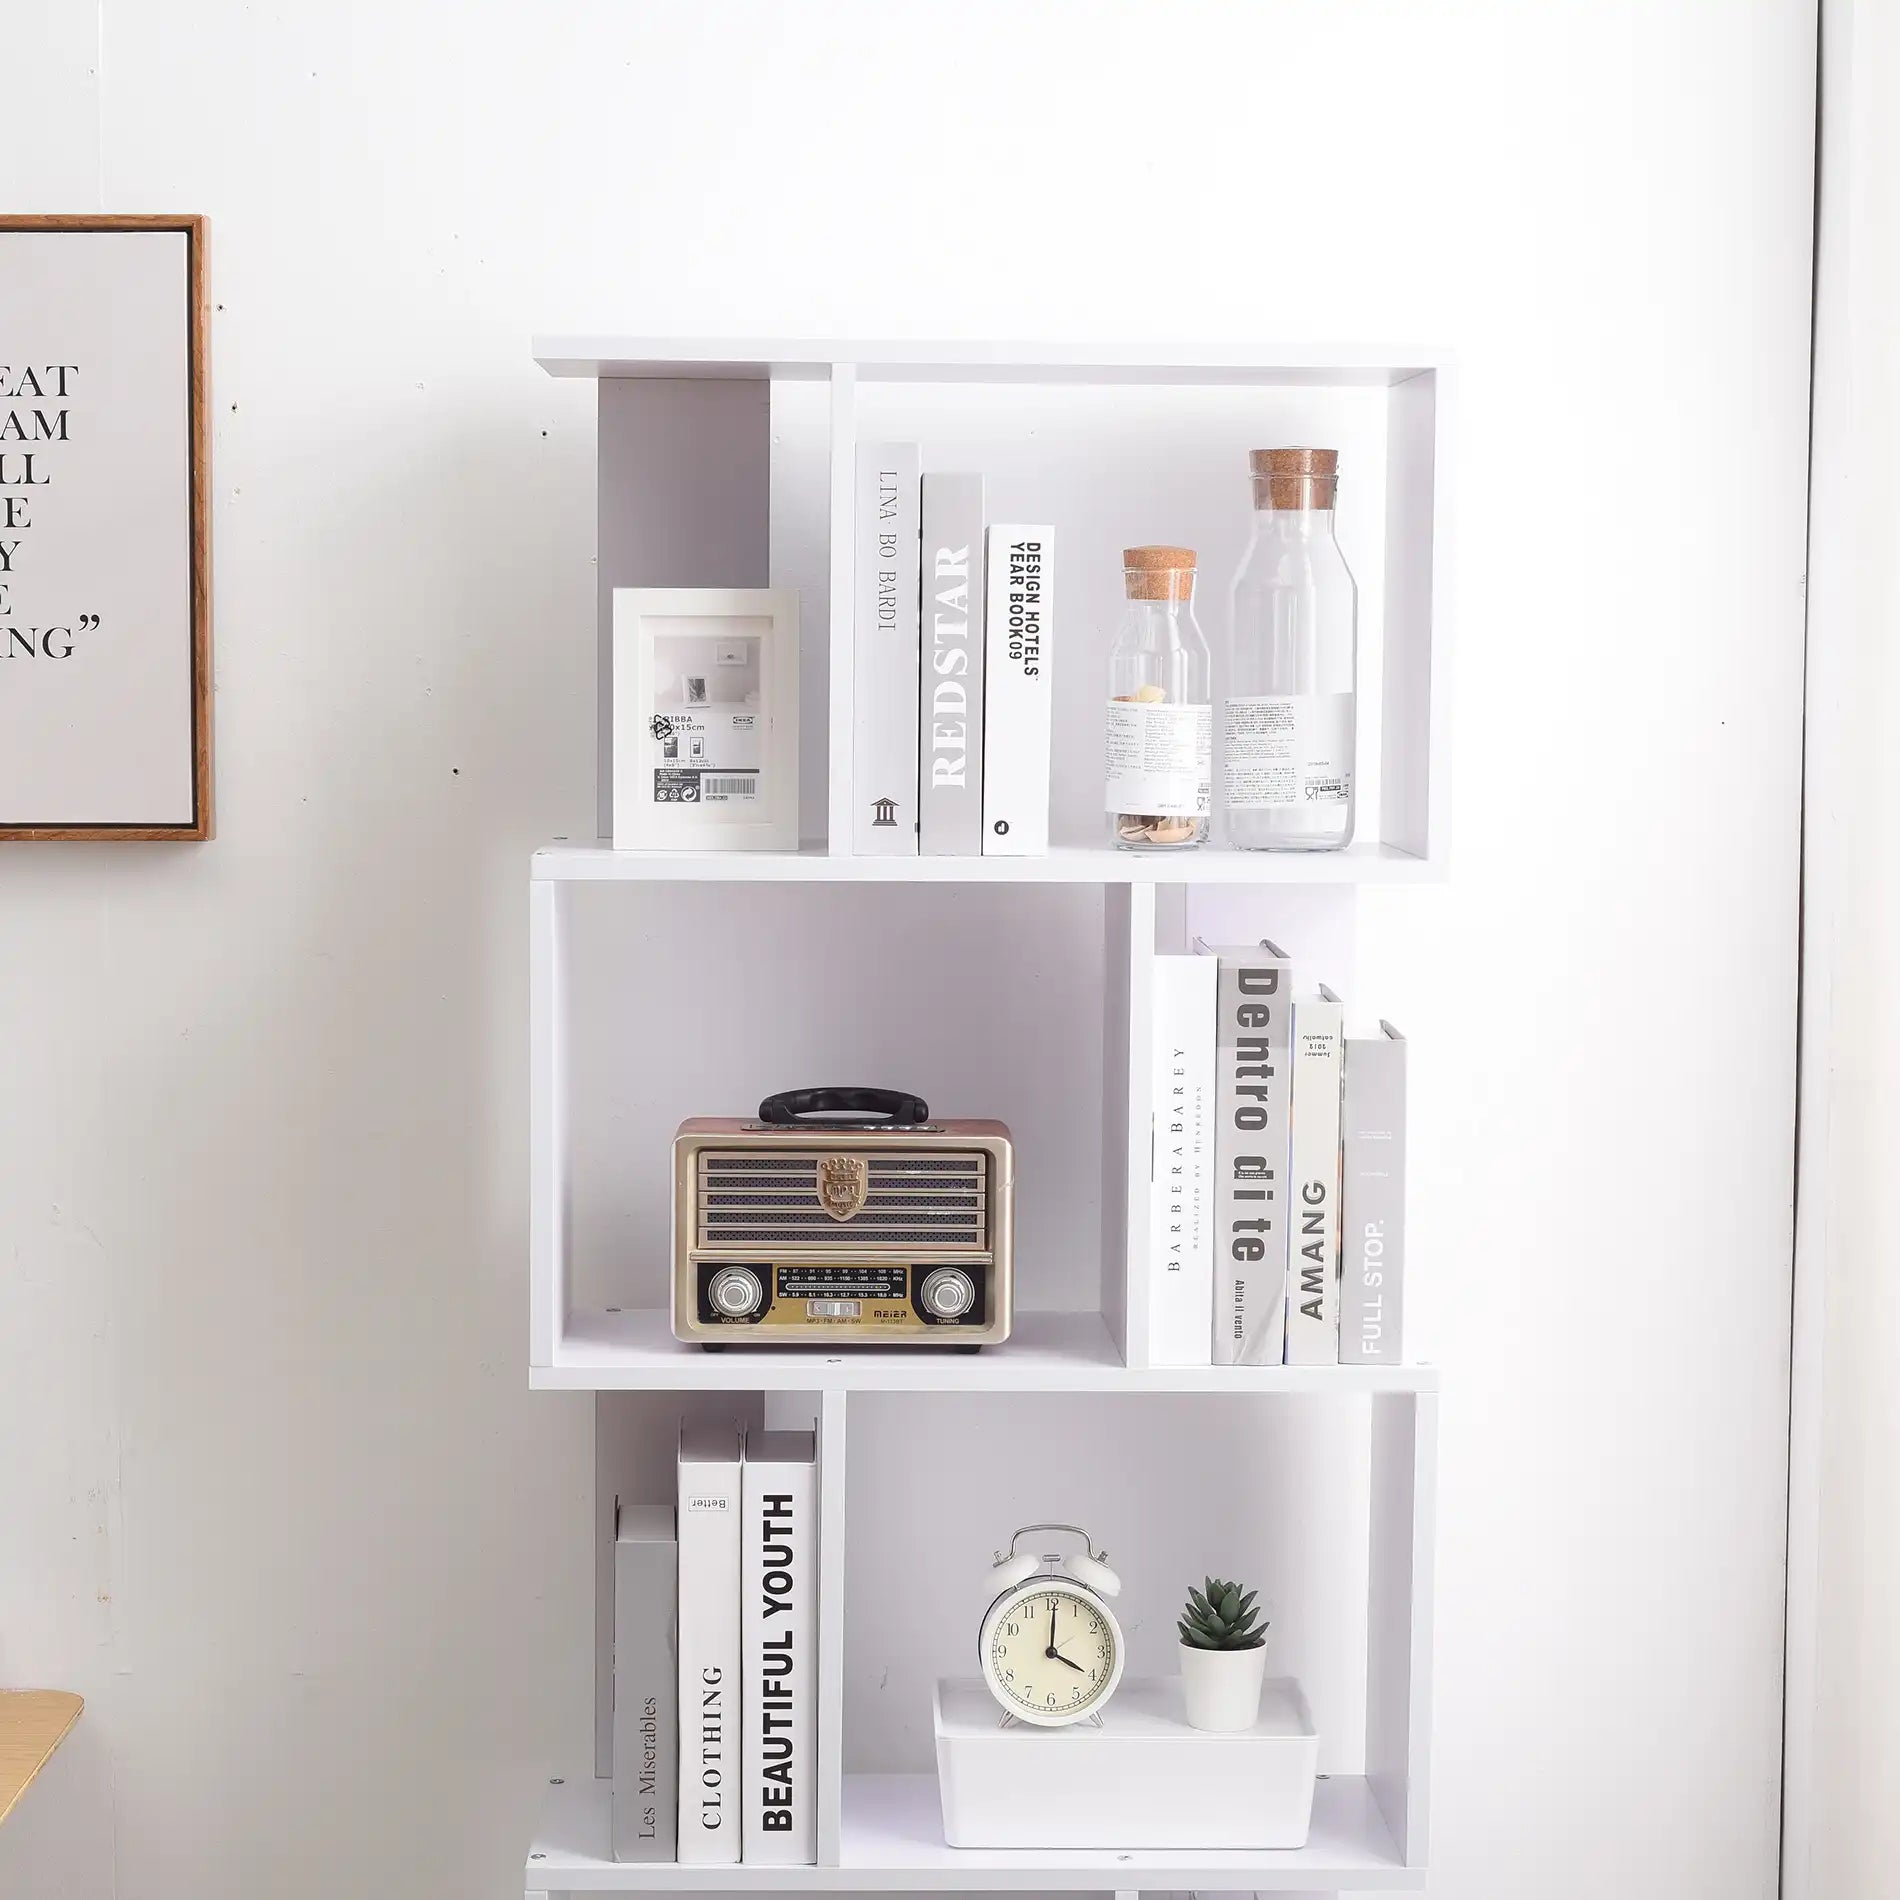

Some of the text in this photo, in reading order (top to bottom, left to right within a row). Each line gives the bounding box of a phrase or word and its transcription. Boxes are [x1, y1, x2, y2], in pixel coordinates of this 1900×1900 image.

[878, 471, 898, 631] LINA BO BARDI
[1009, 542, 1025, 586] YEAR
[1025, 542, 1041, 604] DESIGN
[932, 544, 969, 789] REDSTAR
[1234, 968, 1279, 1131] Dentro
[1233, 1156, 1274, 1201] di
[1231, 1218, 1272, 1262] te
[1301, 1182, 1326, 1321] AMANG
[1361, 1219, 1385, 1355] FULL STOP.
[1234, 1314, 1245, 1339] vento
[691, 1499, 726, 1508] Better
[1024, 1606, 1034, 1618] 11
[1073, 1605, 1077, 1617] 1
[1007, 1623, 1019, 1636] 10
[1089, 1621, 1098, 1634] 2
[762, 1494, 794, 1832] BEAUTIFUL YOUTH
[998, 1645, 1007, 1658] 9
[1097, 1646, 1105, 1658] 3
[1006, 1669, 1014, 1682] 8
[1088, 1669, 1097, 1681] 4
[1025, 1686, 1032, 1698] 7
[1047, 1693, 1055, 1705] 6
[1072, 1687, 1080, 1699] 5
[701, 1666, 723, 1830] CLOTHING
[638, 1696, 657, 1839] Les Miserables
